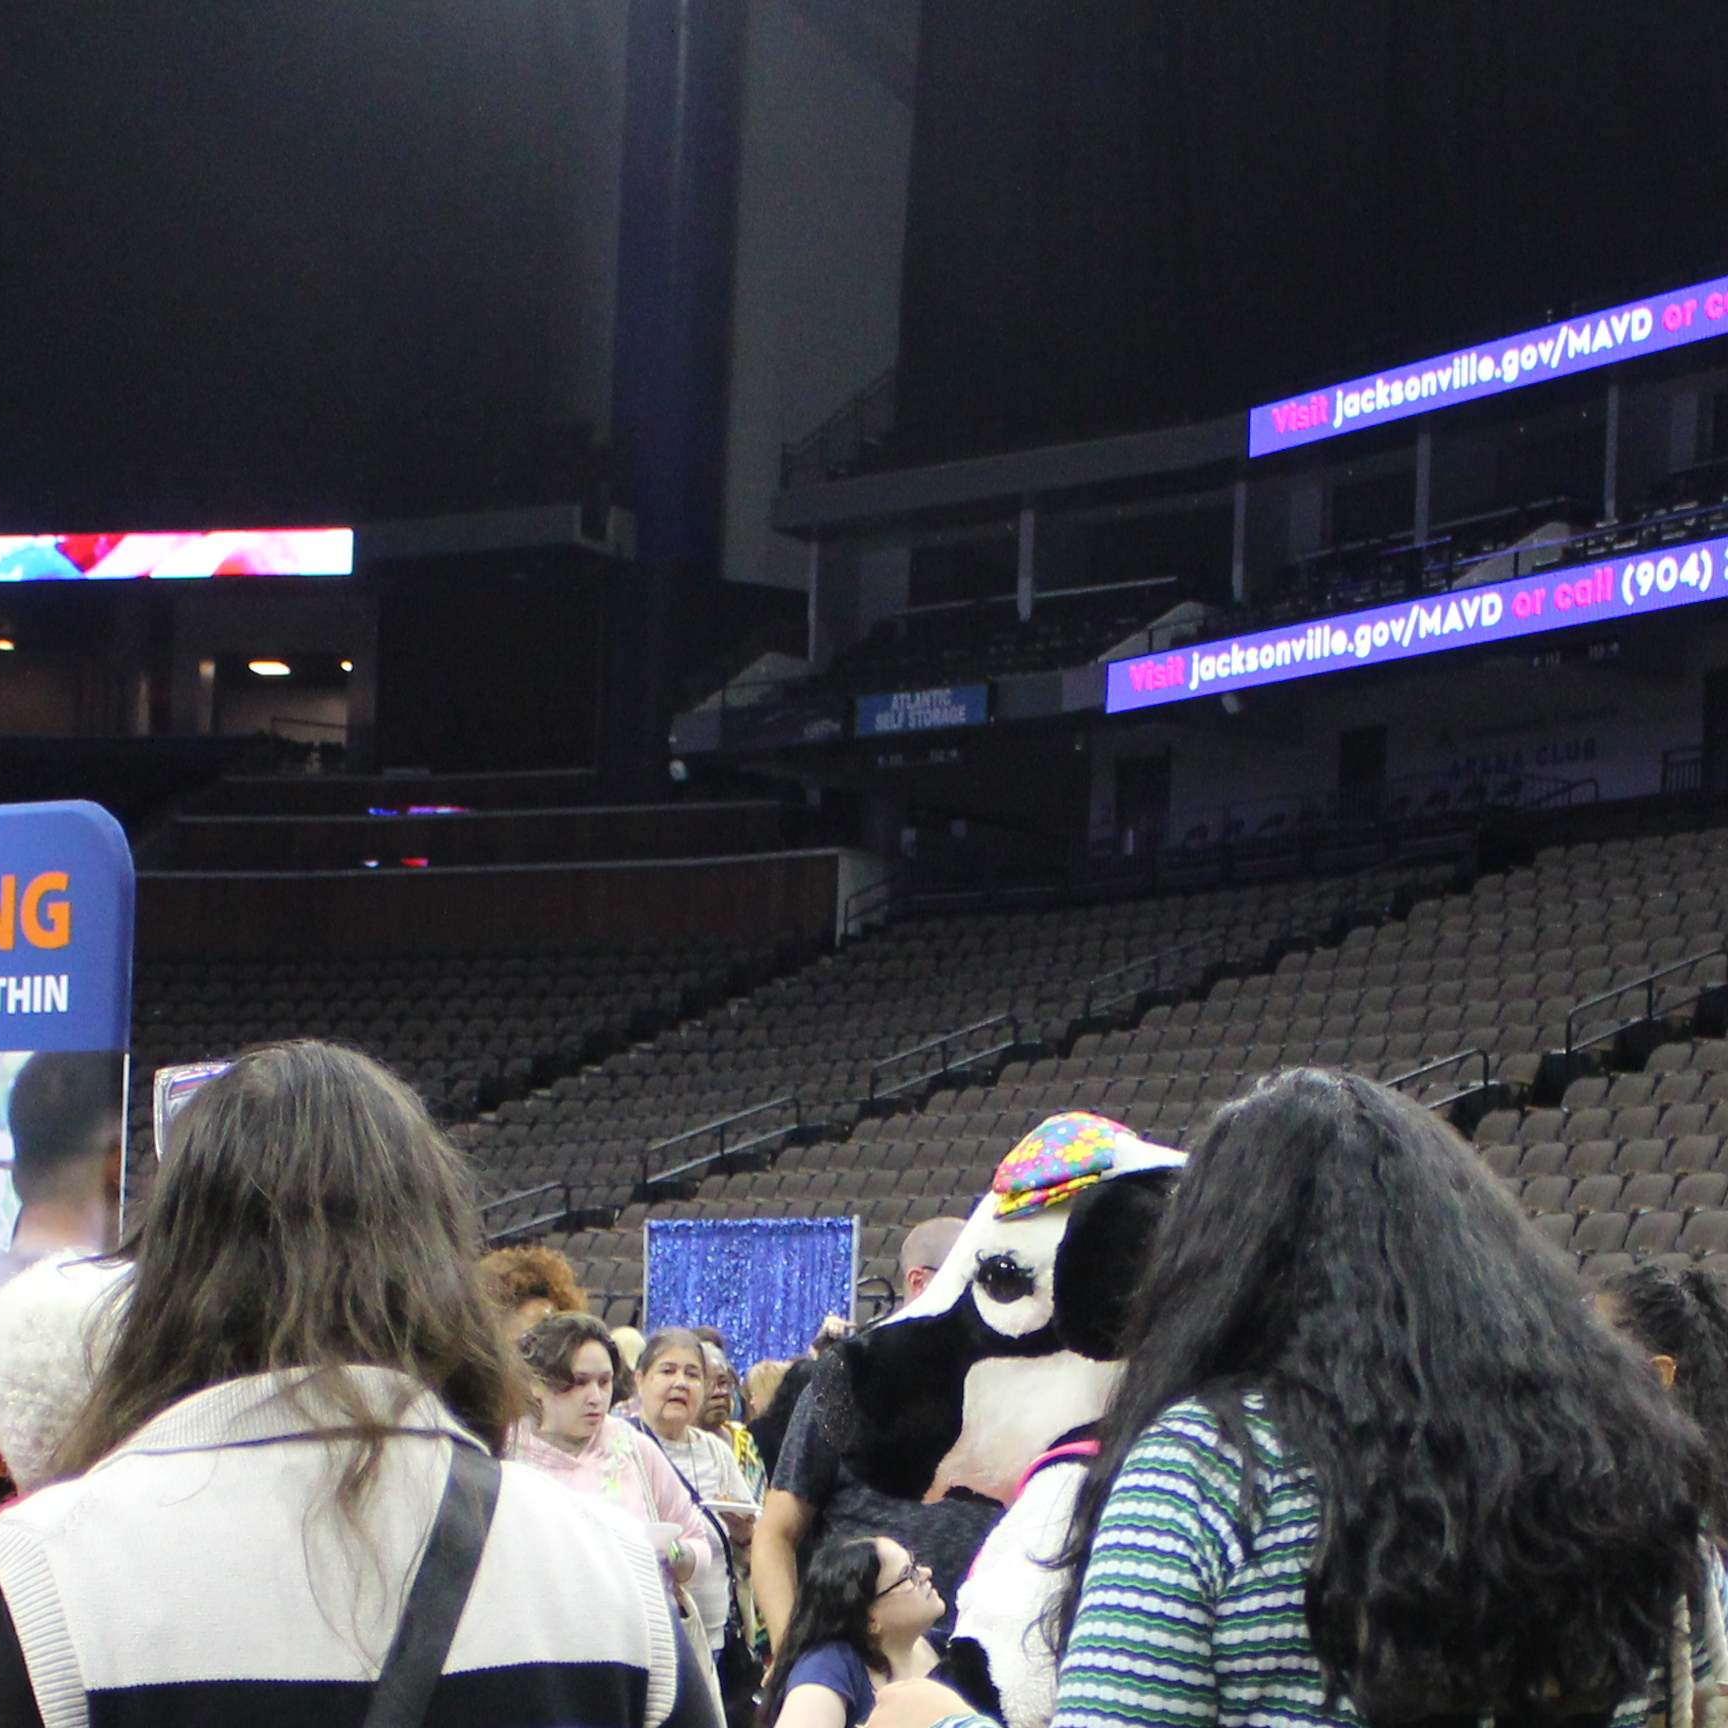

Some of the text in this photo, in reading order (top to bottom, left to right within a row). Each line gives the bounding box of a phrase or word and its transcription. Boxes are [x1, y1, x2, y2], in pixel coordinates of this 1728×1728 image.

[1272, 401, 1329, 436] Visit
[1333, 310, 1653, 428] jacksonville.gov/MAVD
[1662, 297, 1698, 333] or
[1128, 657, 1185, 695] Visit
[1188, 590, 1504, 684] jacksonville.gov/MAVD
[1510, 585, 1546, 621] or
[1553, 567, 1614, 612] call
[1620, 549, 1713, 605] (904)
[874, 704, 968, 732] SELF STORAGE
[890, 688, 953, 711] ATLANTIC
